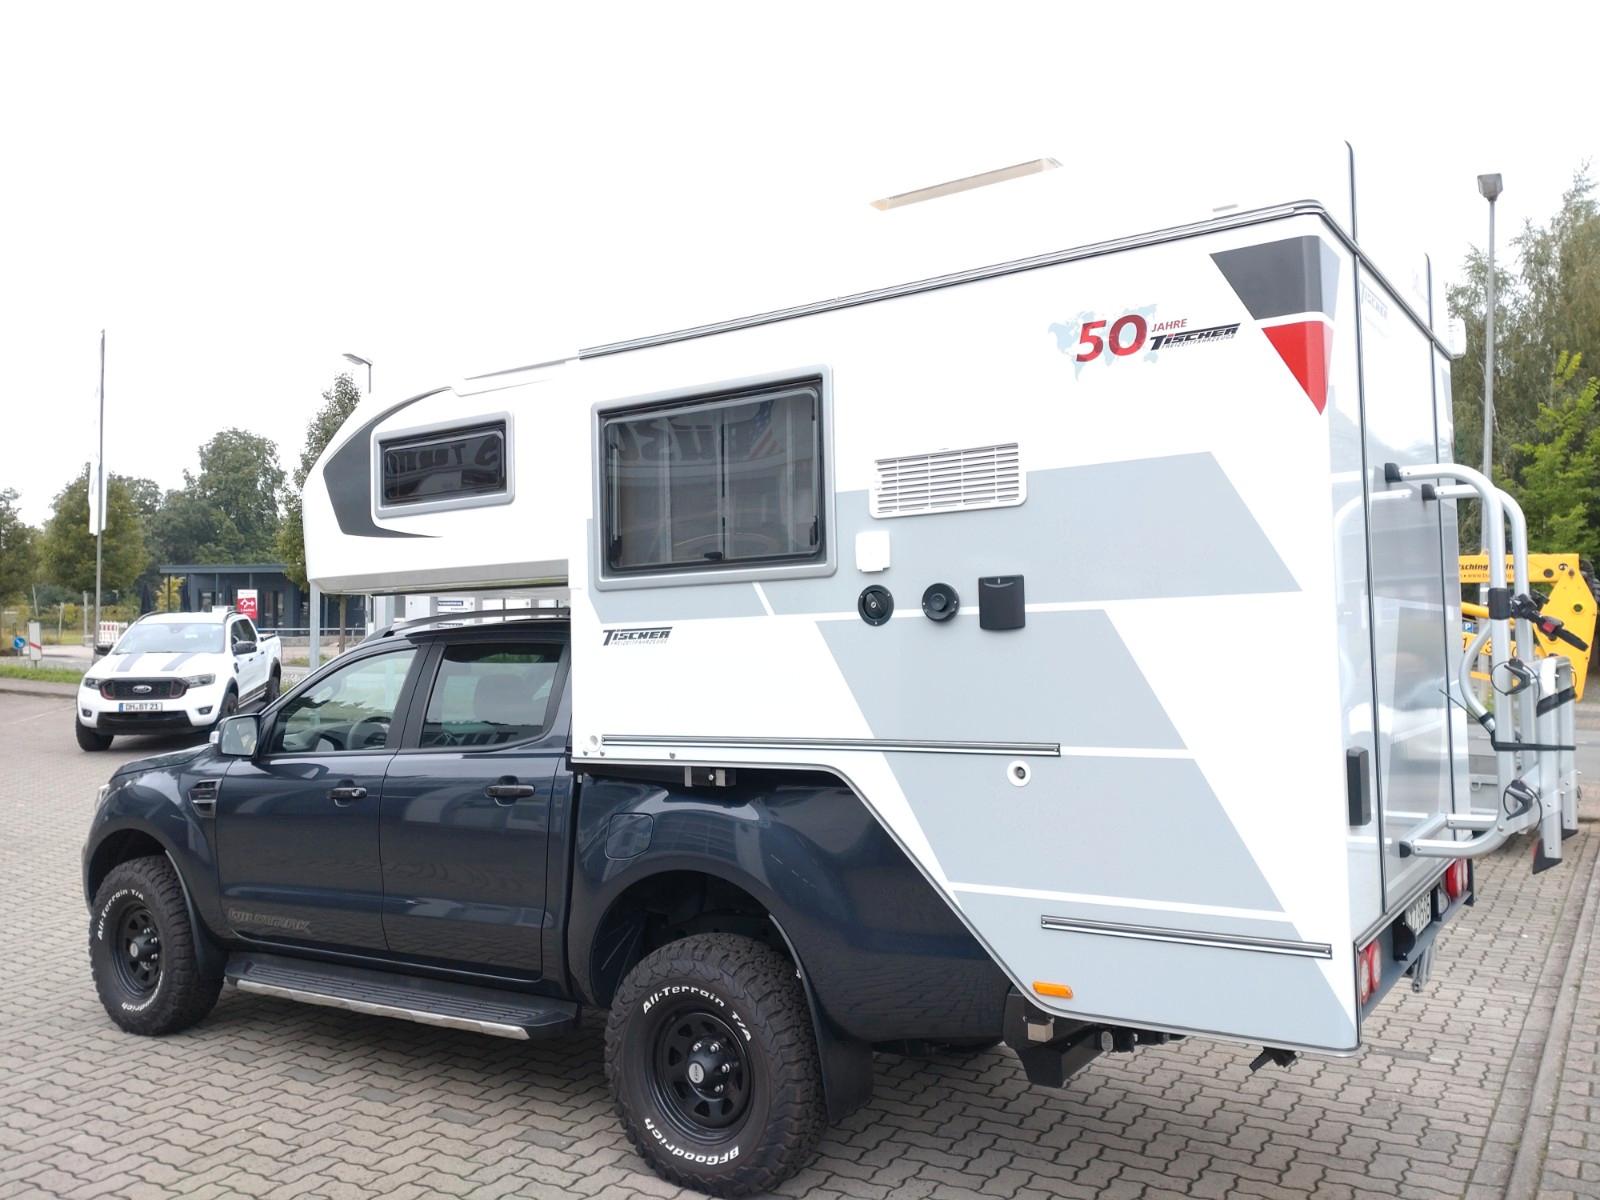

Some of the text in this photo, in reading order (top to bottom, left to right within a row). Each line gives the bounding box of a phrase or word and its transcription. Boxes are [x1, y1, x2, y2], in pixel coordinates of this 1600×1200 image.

[1076, 314, 1148, 363] 50
[1152, 318, 1188, 333] JAHRE
[97, 888, 144, 940] All-Terrain T/A
[642, 985, 752, 1042] All-Terrain T/A
[644, 1117, 740, 1166] BFGoodrich
